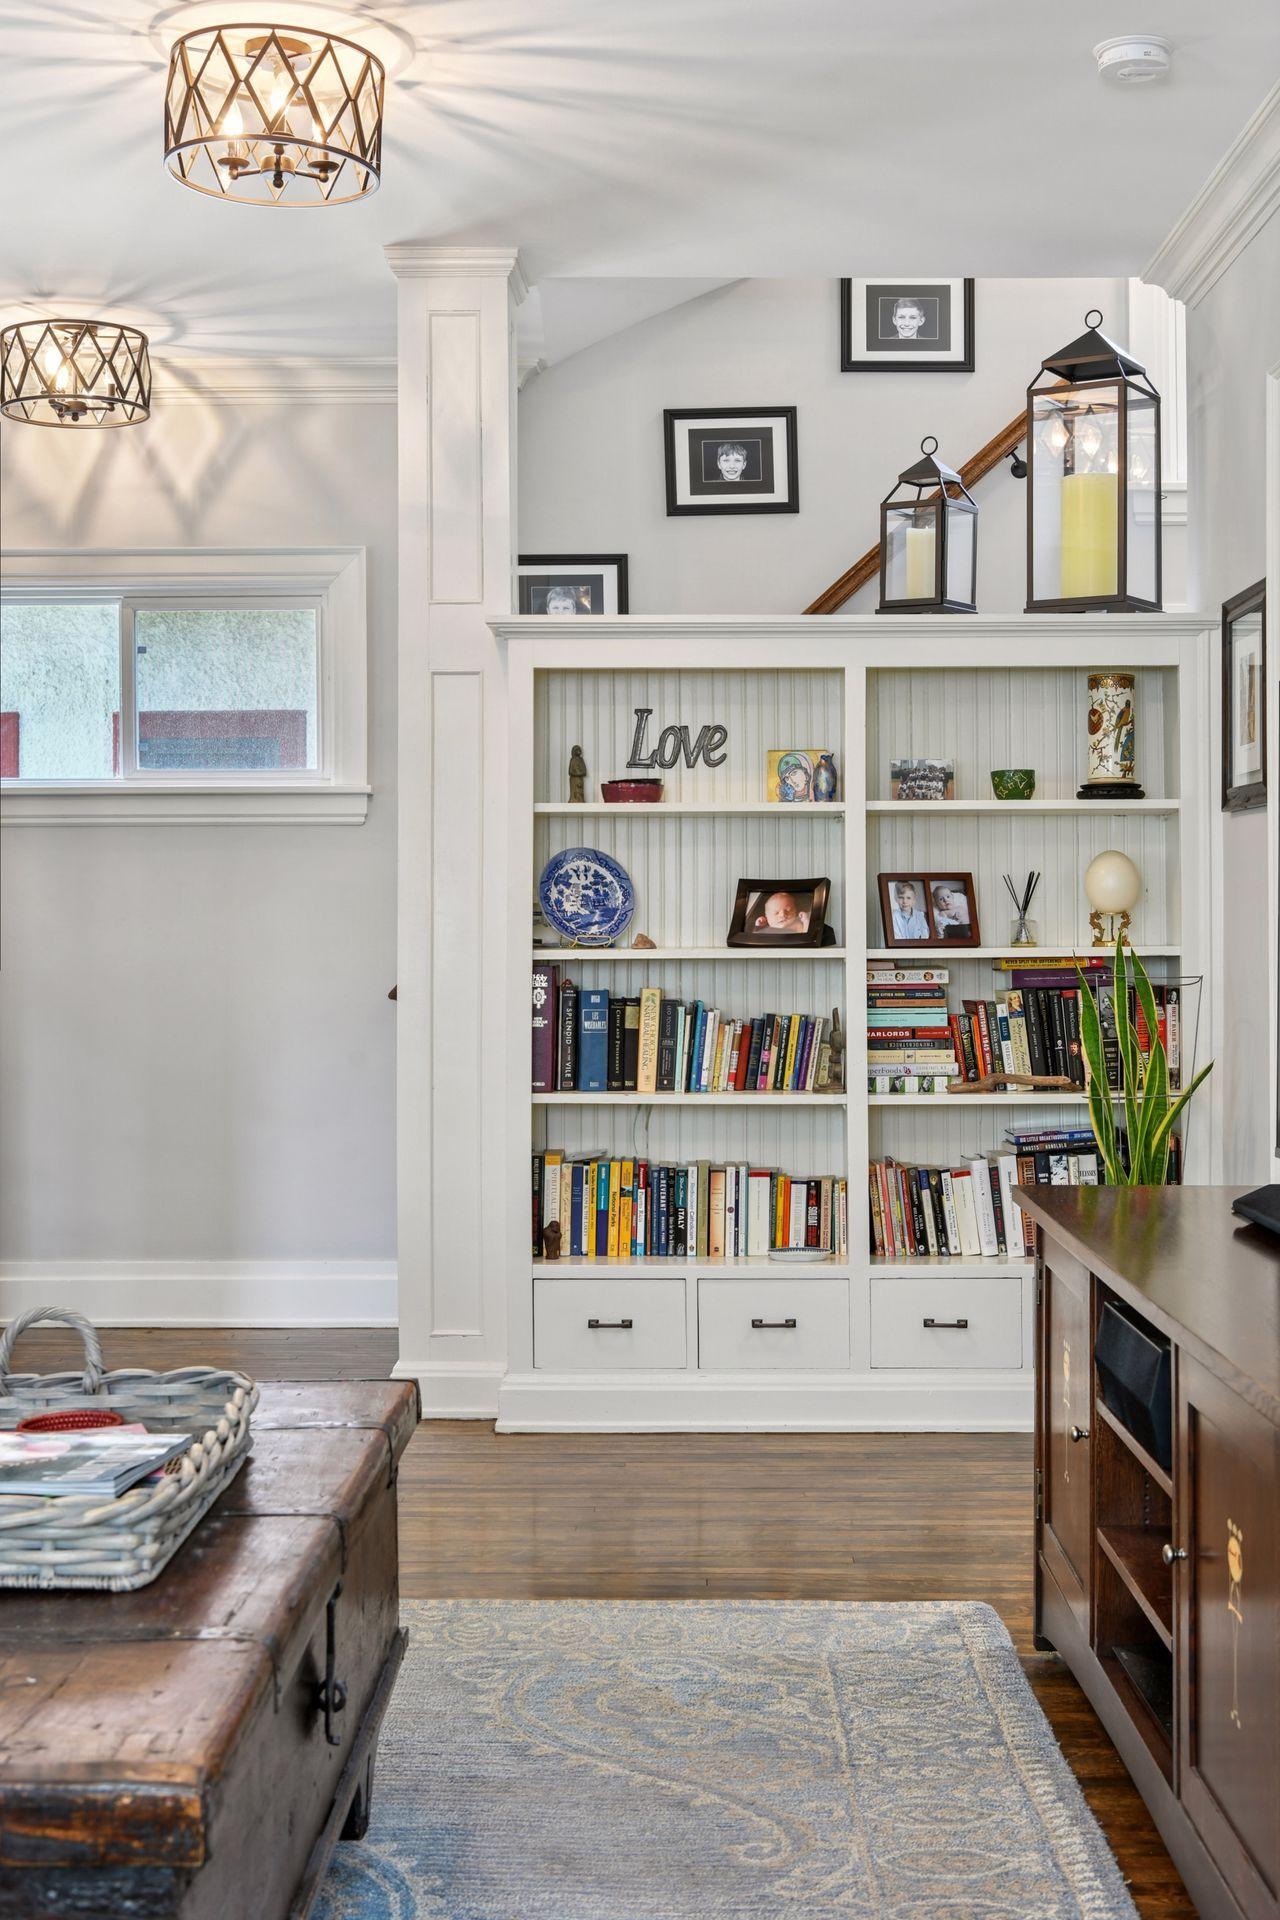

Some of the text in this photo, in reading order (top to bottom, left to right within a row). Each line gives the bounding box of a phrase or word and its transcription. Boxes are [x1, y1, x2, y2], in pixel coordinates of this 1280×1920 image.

[626, 708, 728, 769] Love
[565, 1008, 573, 1045] SPLENDID
[978, 1004, 987, 1036] COUNTDOWN
[641, 1004, 651, 1071] NATURAL HEALING
[564, 1062, 573, 1078] VILE
[550, 1167, 558, 1205] SPIRITUAL
[659, 1179, 667, 1211] REVENANT
[677, 1208, 685, 1230] ITALY
[807, 1206, 818, 1226] SOLDAT
